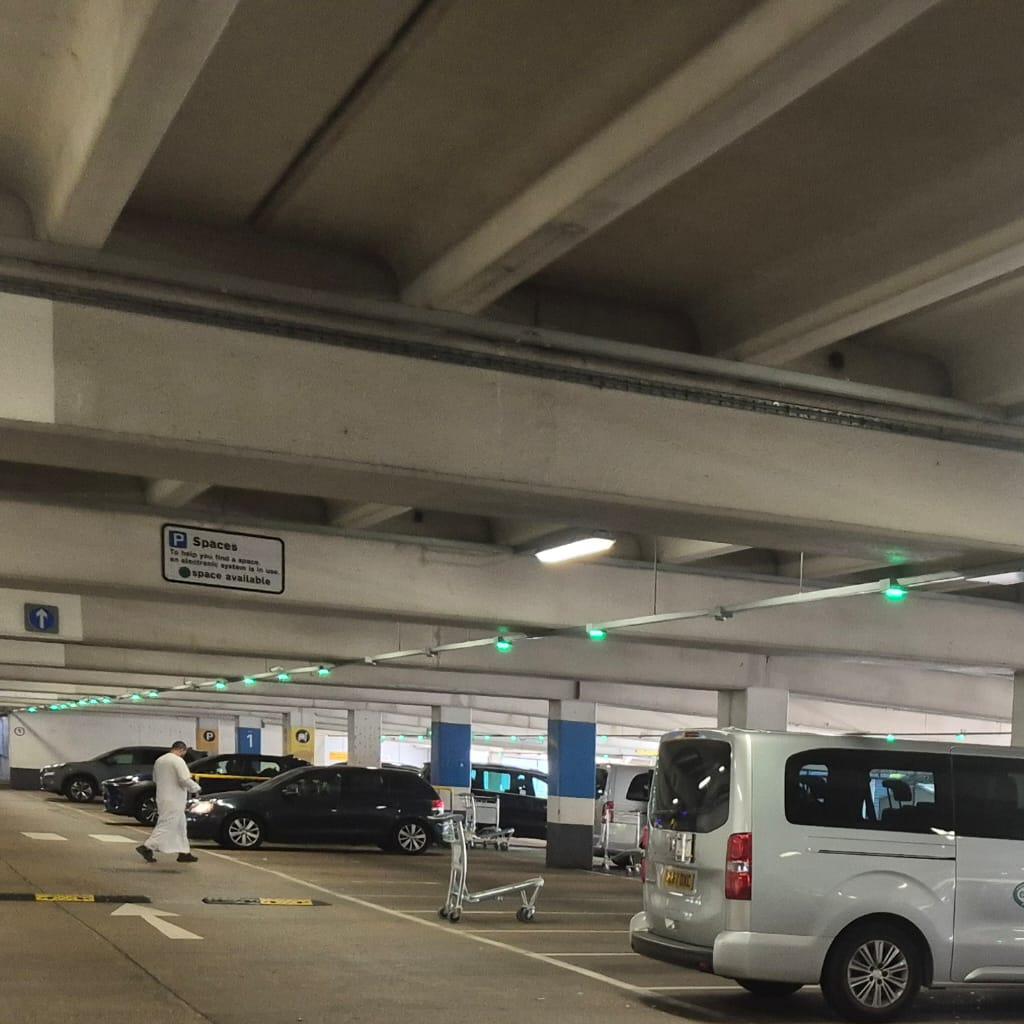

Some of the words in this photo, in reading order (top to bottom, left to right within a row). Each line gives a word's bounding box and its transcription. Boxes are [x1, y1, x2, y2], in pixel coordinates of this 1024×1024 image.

[173, 533, 184, 547] P
[192, 536, 238, 551] Spaces
[181, 550, 198, 558] help
[181, 558, 218, 568] electronic
[221, 563, 247, 571] system
[192, 570, 222, 580] space
[225, 573, 271, 586] available
[246, 734, 253, 748] 1
